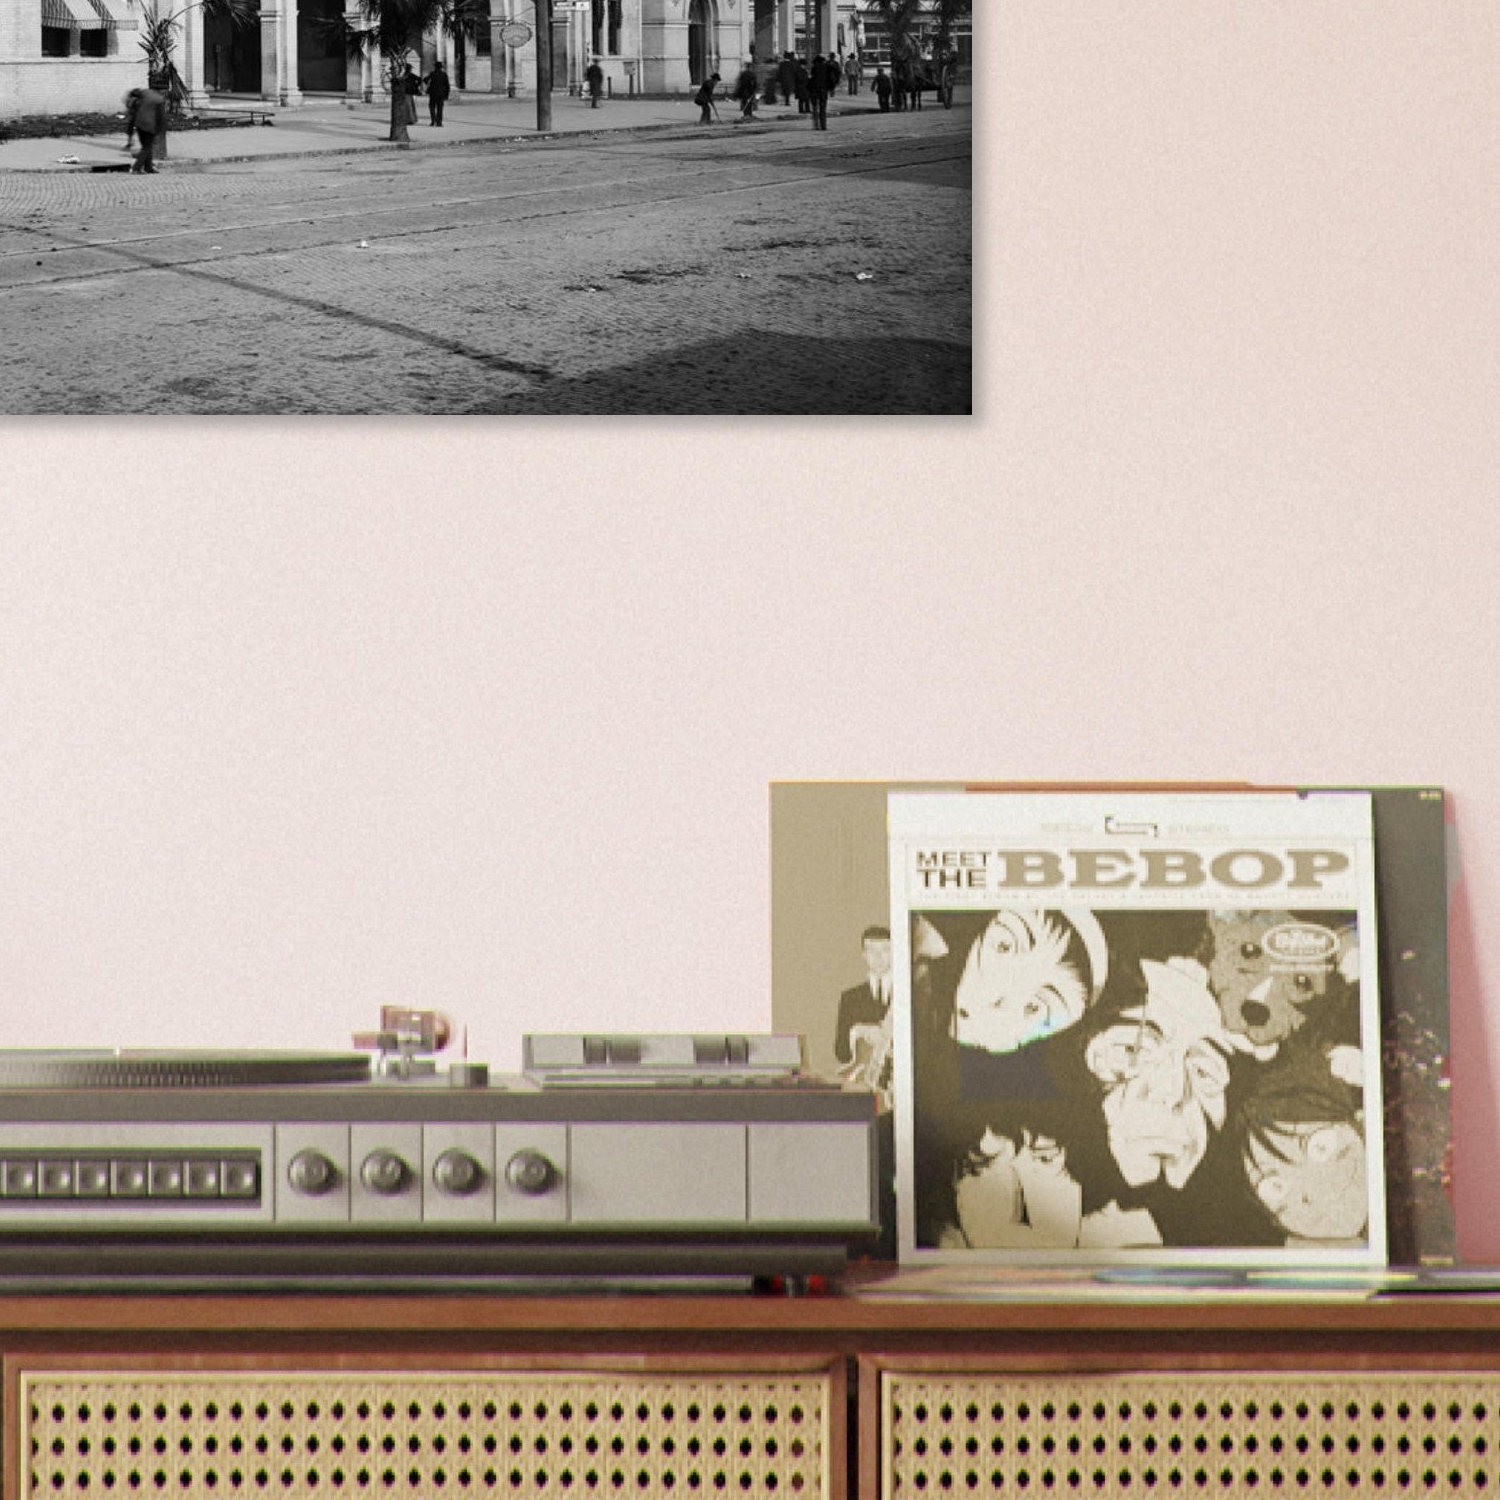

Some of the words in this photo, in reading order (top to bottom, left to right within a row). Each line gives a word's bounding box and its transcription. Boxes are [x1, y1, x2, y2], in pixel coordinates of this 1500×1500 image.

[916, 851, 991, 867] MEET
[997, 849, 1350, 890] BEBOP
[916, 868, 987, 889] THE
